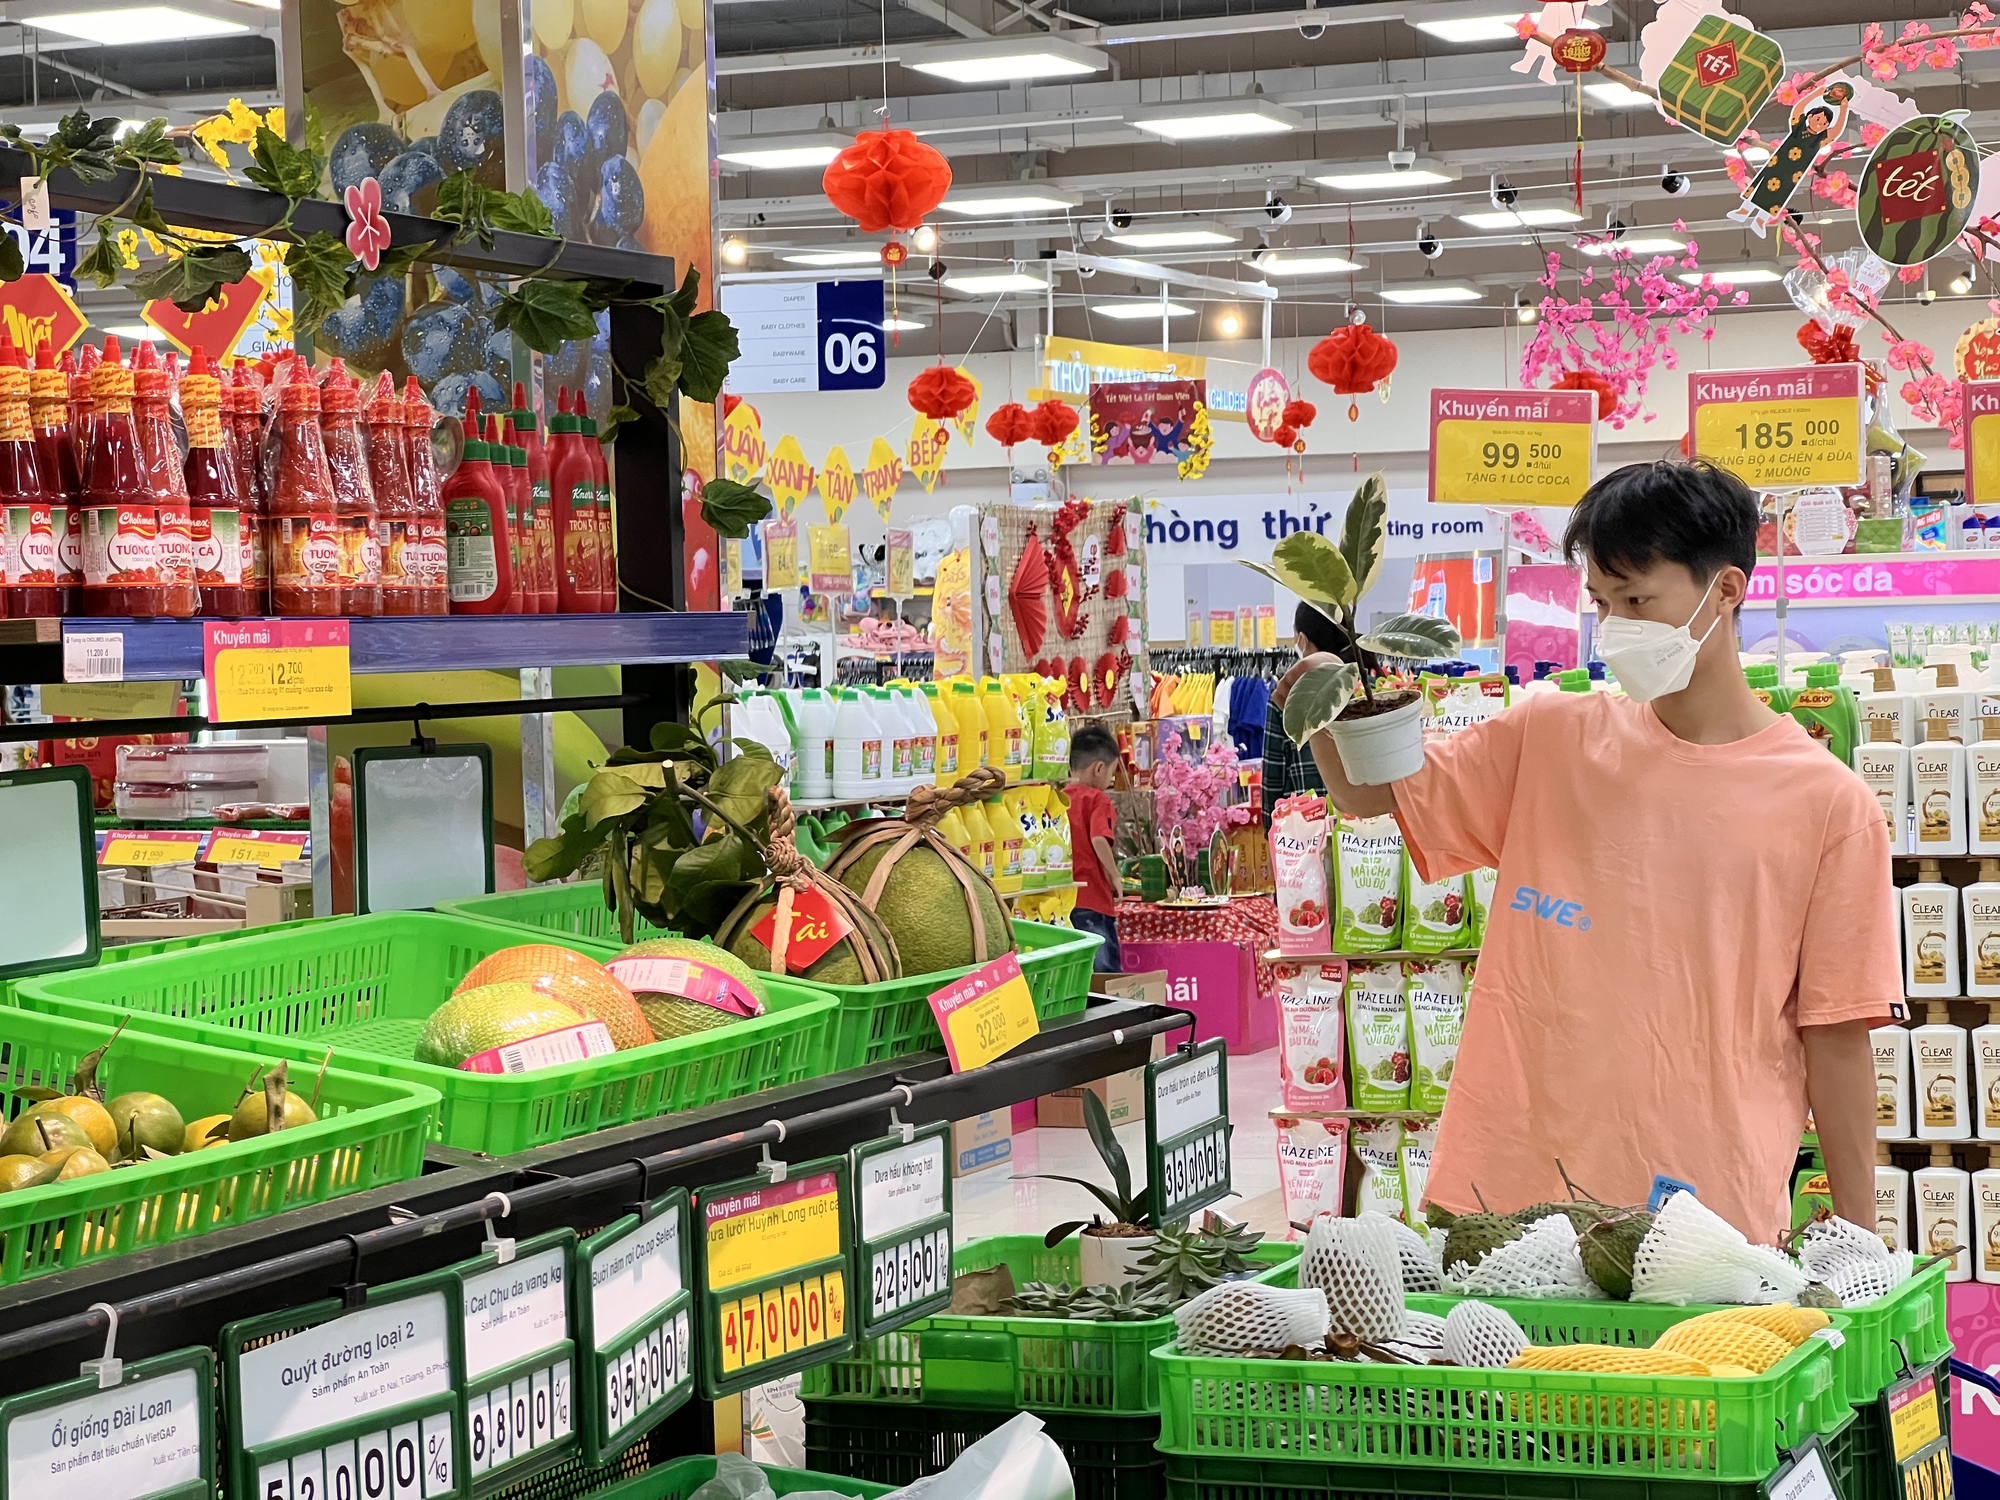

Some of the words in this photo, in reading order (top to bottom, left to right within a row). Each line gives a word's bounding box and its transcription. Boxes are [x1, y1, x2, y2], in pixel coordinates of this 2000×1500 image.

[1703, 54, 1731, 76] TẾT
[1882, 165, 1940, 202] tết
[761, 323, 776, 331] BABY
[777, 322, 805, 330] CLOTHES
[824, 332, 877, 375] 06
[773, 377, 788, 385] BABY
[1697, 378, 1771, 402] Khuyến
[1777, 378, 1813, 397] mãi
[1211, 389, 1247, 412] CHILDRE
[1439, 397, 1509, 420] Khuyến
[1515, 402, 1548, 419] mãi
[911, 428, 938, 467] BẾP
[1735, 422, 1794, 450] 185
[1805, 420, 1839, 436] 000
[1808, 438, 1836, 447] đ/chai
[1483, 442, 1519, 469] 99
[1530, 444, 1562, 459] 500
[1769, 454, 1775, 463] 4
[1817, 453, 1823, 461] 4
[769, 457, 815, 493] XANH
[825, 465, 855, 504] TÂN
[861, 457, 903, 499] TRANG
[1466, 472, 1497, 484] TẶNG
[1501, 474, 1506, 483] 1
[1538, 475, 1570, 485] COCA
[1755, 469, 1761, 478] 2
[1147, 510, 1239, 549] hòng
[1432, 519, 1483, 534] room
[116, 544, 150, 556] TƯƠNG
[199, 544, 214, 556] CÀ
[1785, 566, 1843, 594] sóc
[1853, 566, 1893, 592] da
[213, 627, 250, 648] Khuyến
[253, 629, 270, 644] mãi
[268, 662, 285, 685] 12
[288, 662, 302, 674] 700
[1863, 762, 1895, 773] CLEAR
[1917, 762, 1948, 773] CLEAR
[112, 831, 135, 840] Khuyến
[1351, 864, 1390, 878] MATCHA
[1510, 886, 1583, 927] SWE
[1912, 903, 1943, 914] CLEAR
[937, 989, 962, 1013] Khuyến
[963, 983, 976, 1002] mãi
[976, 1019, 995, 1050] 32
[993, 1012, 1006, 1030] 000
[1872, 1047, 1894, 1057] LEAR
[1921, 1046, 1952, 1057] CLEAR
[1158, 1085, 1168, 1098] Dưa
[1169, 1080, 1179, 1092] hấu
[1179, 1076, 1189, 1090] tròn
[1189, 1071, 1197, 1084] vỏ
[1197, 1069, 1206, 1082] đen
[875, 1168, 887, 1184] Dưa
[889, 1162, 901, 1181] hấu
[902, 1159, 923, 1176] không
[923, 1156, 933, 1174] hạt
[1165, 1145, 1214, 1196] 33.000
[744, 1191, 760, 1209] mãi
[1923, 1189, 1954, 1201] CLEAR
[726, 1219, 746, 1237] lưới
[748, 1212, 779, 1233] Huỳnh
[782, 1208, 806, 1223] Long
[808, 1200, 830, 1218] ruột
[625, 1247, 635, 1267] roi
[635, 1238, 654, 1261] Co.op
[656, 1223, 676, 1248] Select
[470, 1294, 487, 1314] Cat
[489, 1287, 510, 1307] Chu
[511, 1280, 524, 1298] da
[525, 1274, 549, 1294] vang
[550, 1264, 562, 1283] kg
[874, 1245, 933, 1306] 22.500
[509, 1310, 516, 1320] An
[725, 1291, 819, 1354] 47.000
[281, 1359, 318, 1388] Quýt
[321, 1340, 372, 1372] đường
[376, 1328, 402, 1350] loại
[406, 1321, 415, 1338] 2
[332, 1375, 356, 1393] phẩm
[357, 1368, 369, 1382] An
[369, 1361, 390, 1377] Toàn
[610, 1334, 673, 1420] 35.900
[52, 1419, 67, 1448] Ổi
[70, 1414, 109, 1447] giống
[113, 1406, 135, 1430] Đài
[139, 1398, 172, 1423] Loan
[473, 1389, 546, 1462] 8.800
[50, 1461, 67, 1475] Sản
[68, 1453, 90, 1472] phẩm
[91, 1449, 104, 1465] đạt
[105, 1442, 121, 1457] tiêu
[121, 1436, 145, 1453] chuẩn
[146, 1425, 177, 1444] VietGAP
